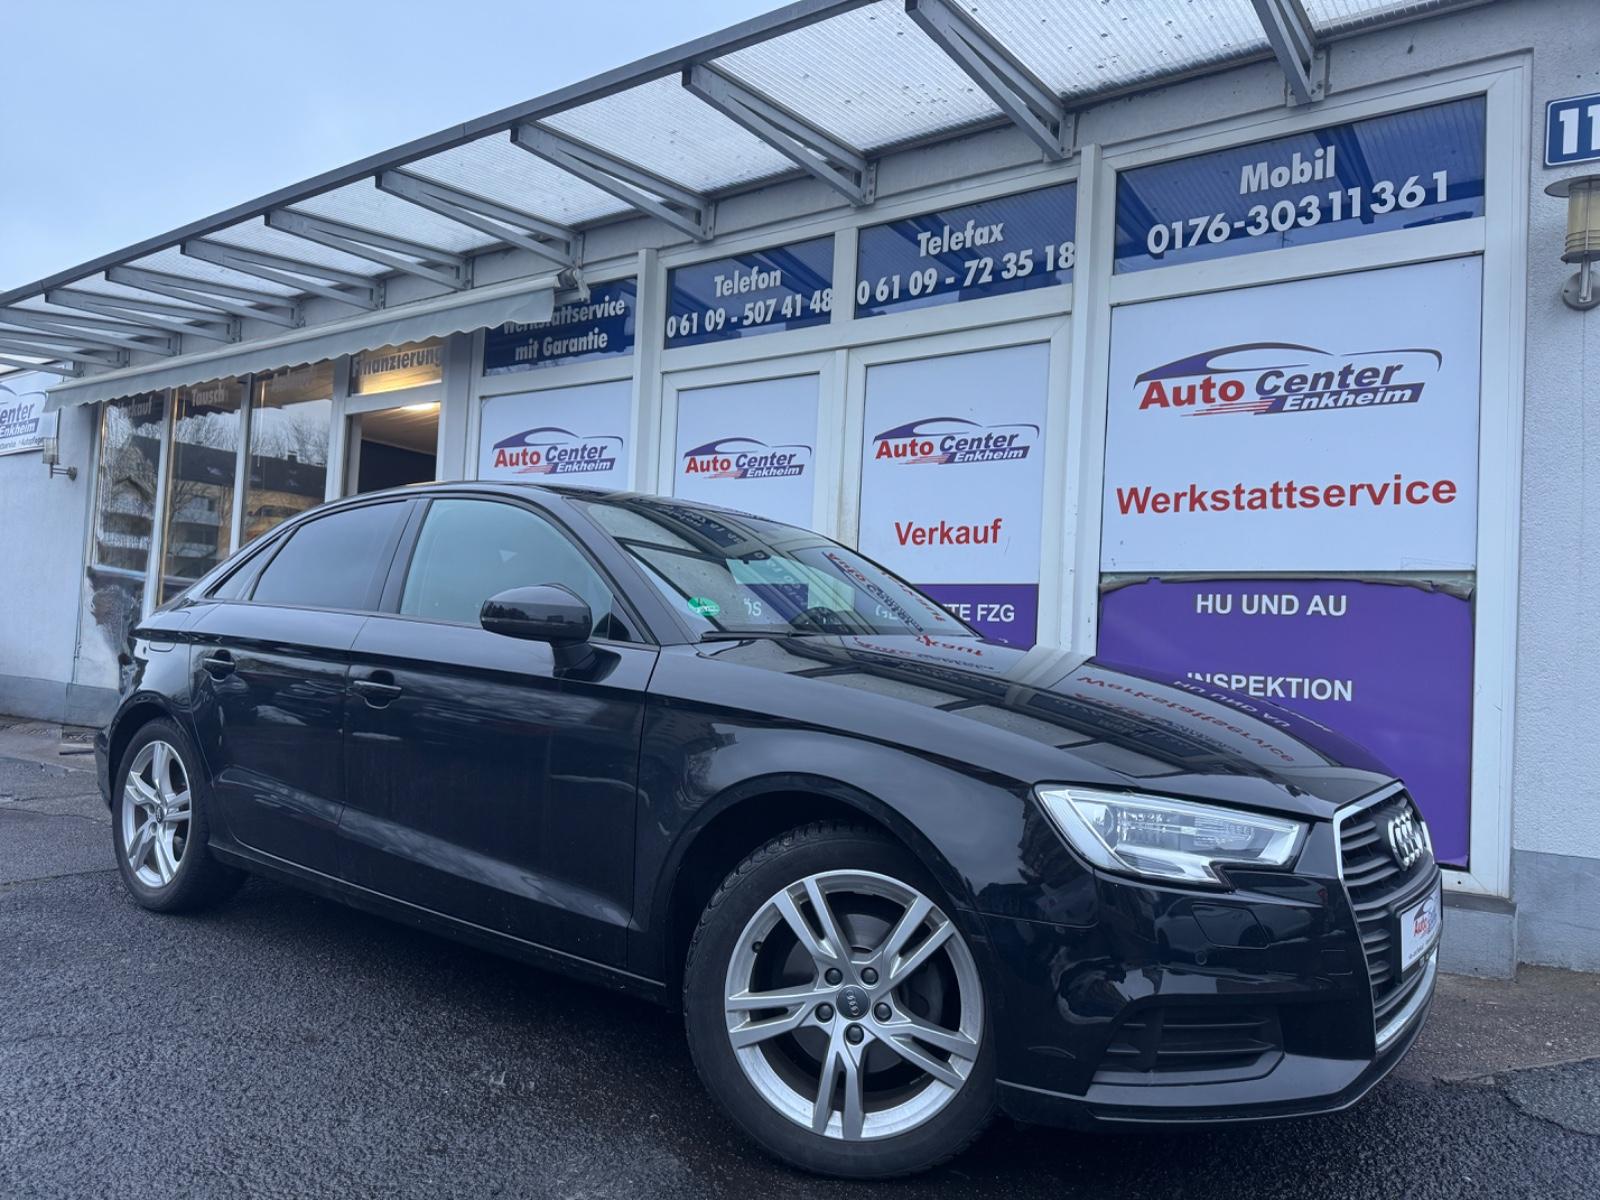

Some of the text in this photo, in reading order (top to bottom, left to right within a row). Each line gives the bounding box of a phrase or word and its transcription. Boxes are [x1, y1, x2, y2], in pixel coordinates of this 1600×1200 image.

[1239, 145, 1336, 194] Mobil
[1147, 170, 1448, 255] 0176-30311361
[917, 219, 1004, 257] Telefax
[714, 266, 781, 297] Telefon
[963, 257, 994, 287] 72
[1001, 249, 1034, 280] 35
[743, 298, 776, 326] 507
[781, 294, 802, 318] 41
[515, 327, 608, 361] mit Garantie
[1139, 362, 1404, 410] Auto Center
[1283, 386, 1413, 411] Enkheim
[494, 443, 608, 467] Auto Center
[875, 432, 1020, 459] Auto Center
[954, 447, 1023, 463] Enkheim
[556, 460, 611, 473] Enkheim
[685, 451, 797, 473] Auto Center
[746, 466, 799, 478] Enkheim
[1116, 473, 1457, 515] Werkstattservice
[894, 518, 1003, 546] Verkauf
[977, 604, 1015, 622] FZG
[1196, 594, 1347, 616] HU UND AU
